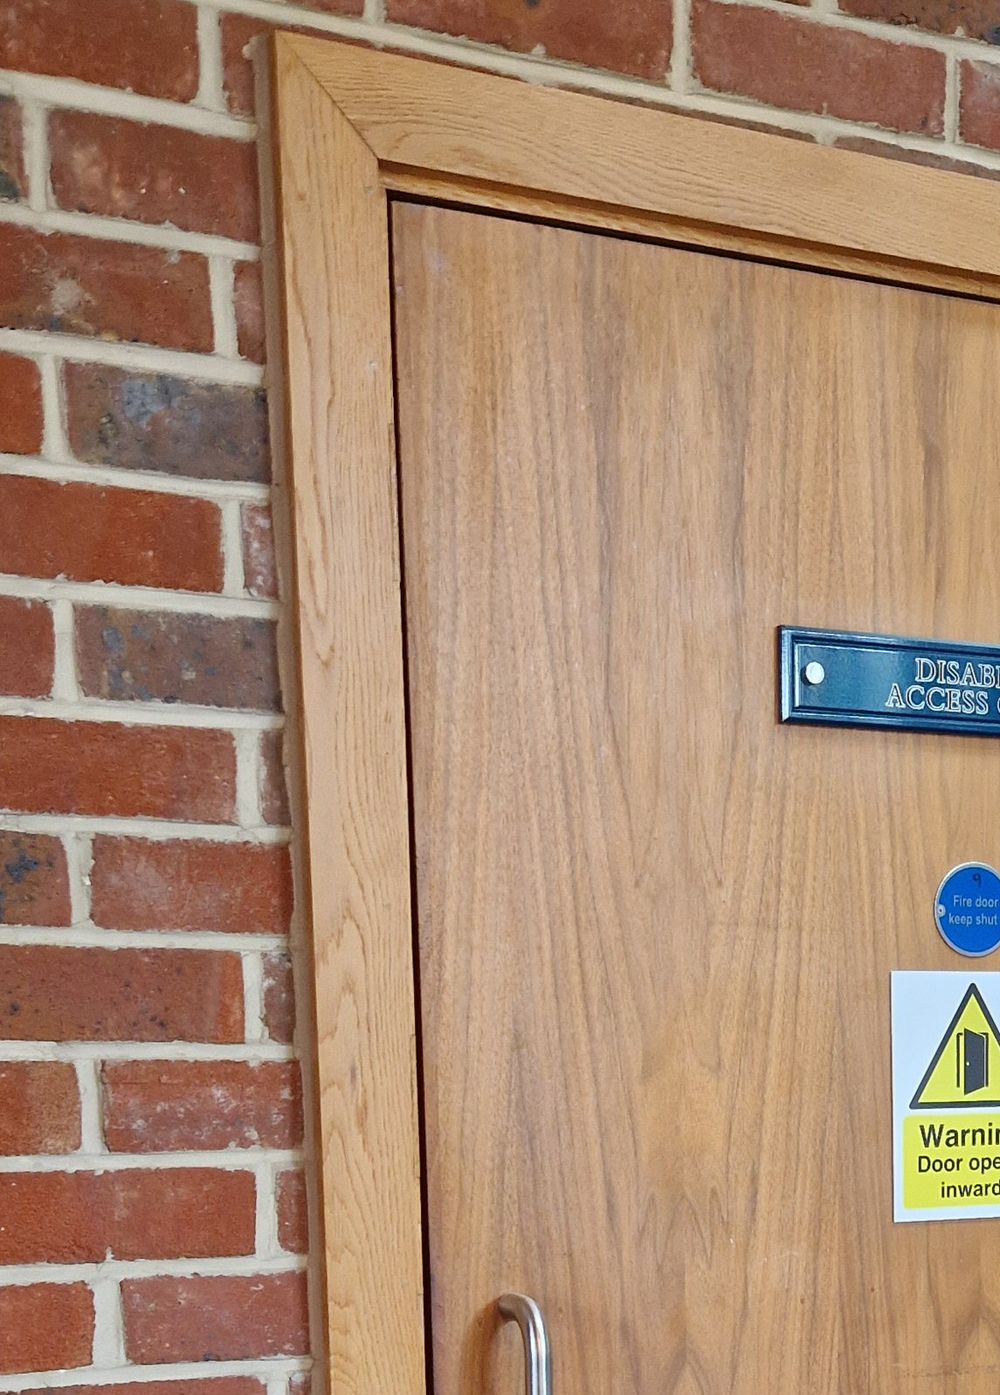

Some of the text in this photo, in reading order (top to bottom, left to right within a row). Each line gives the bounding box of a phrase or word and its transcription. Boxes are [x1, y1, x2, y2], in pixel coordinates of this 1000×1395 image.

[886, 683, 989, 715] ACCESS
[953, 895, 999, 908] Fire door
[948, 913, 998, 927] keep shut
[918, 1155, 963, 1173] Door
